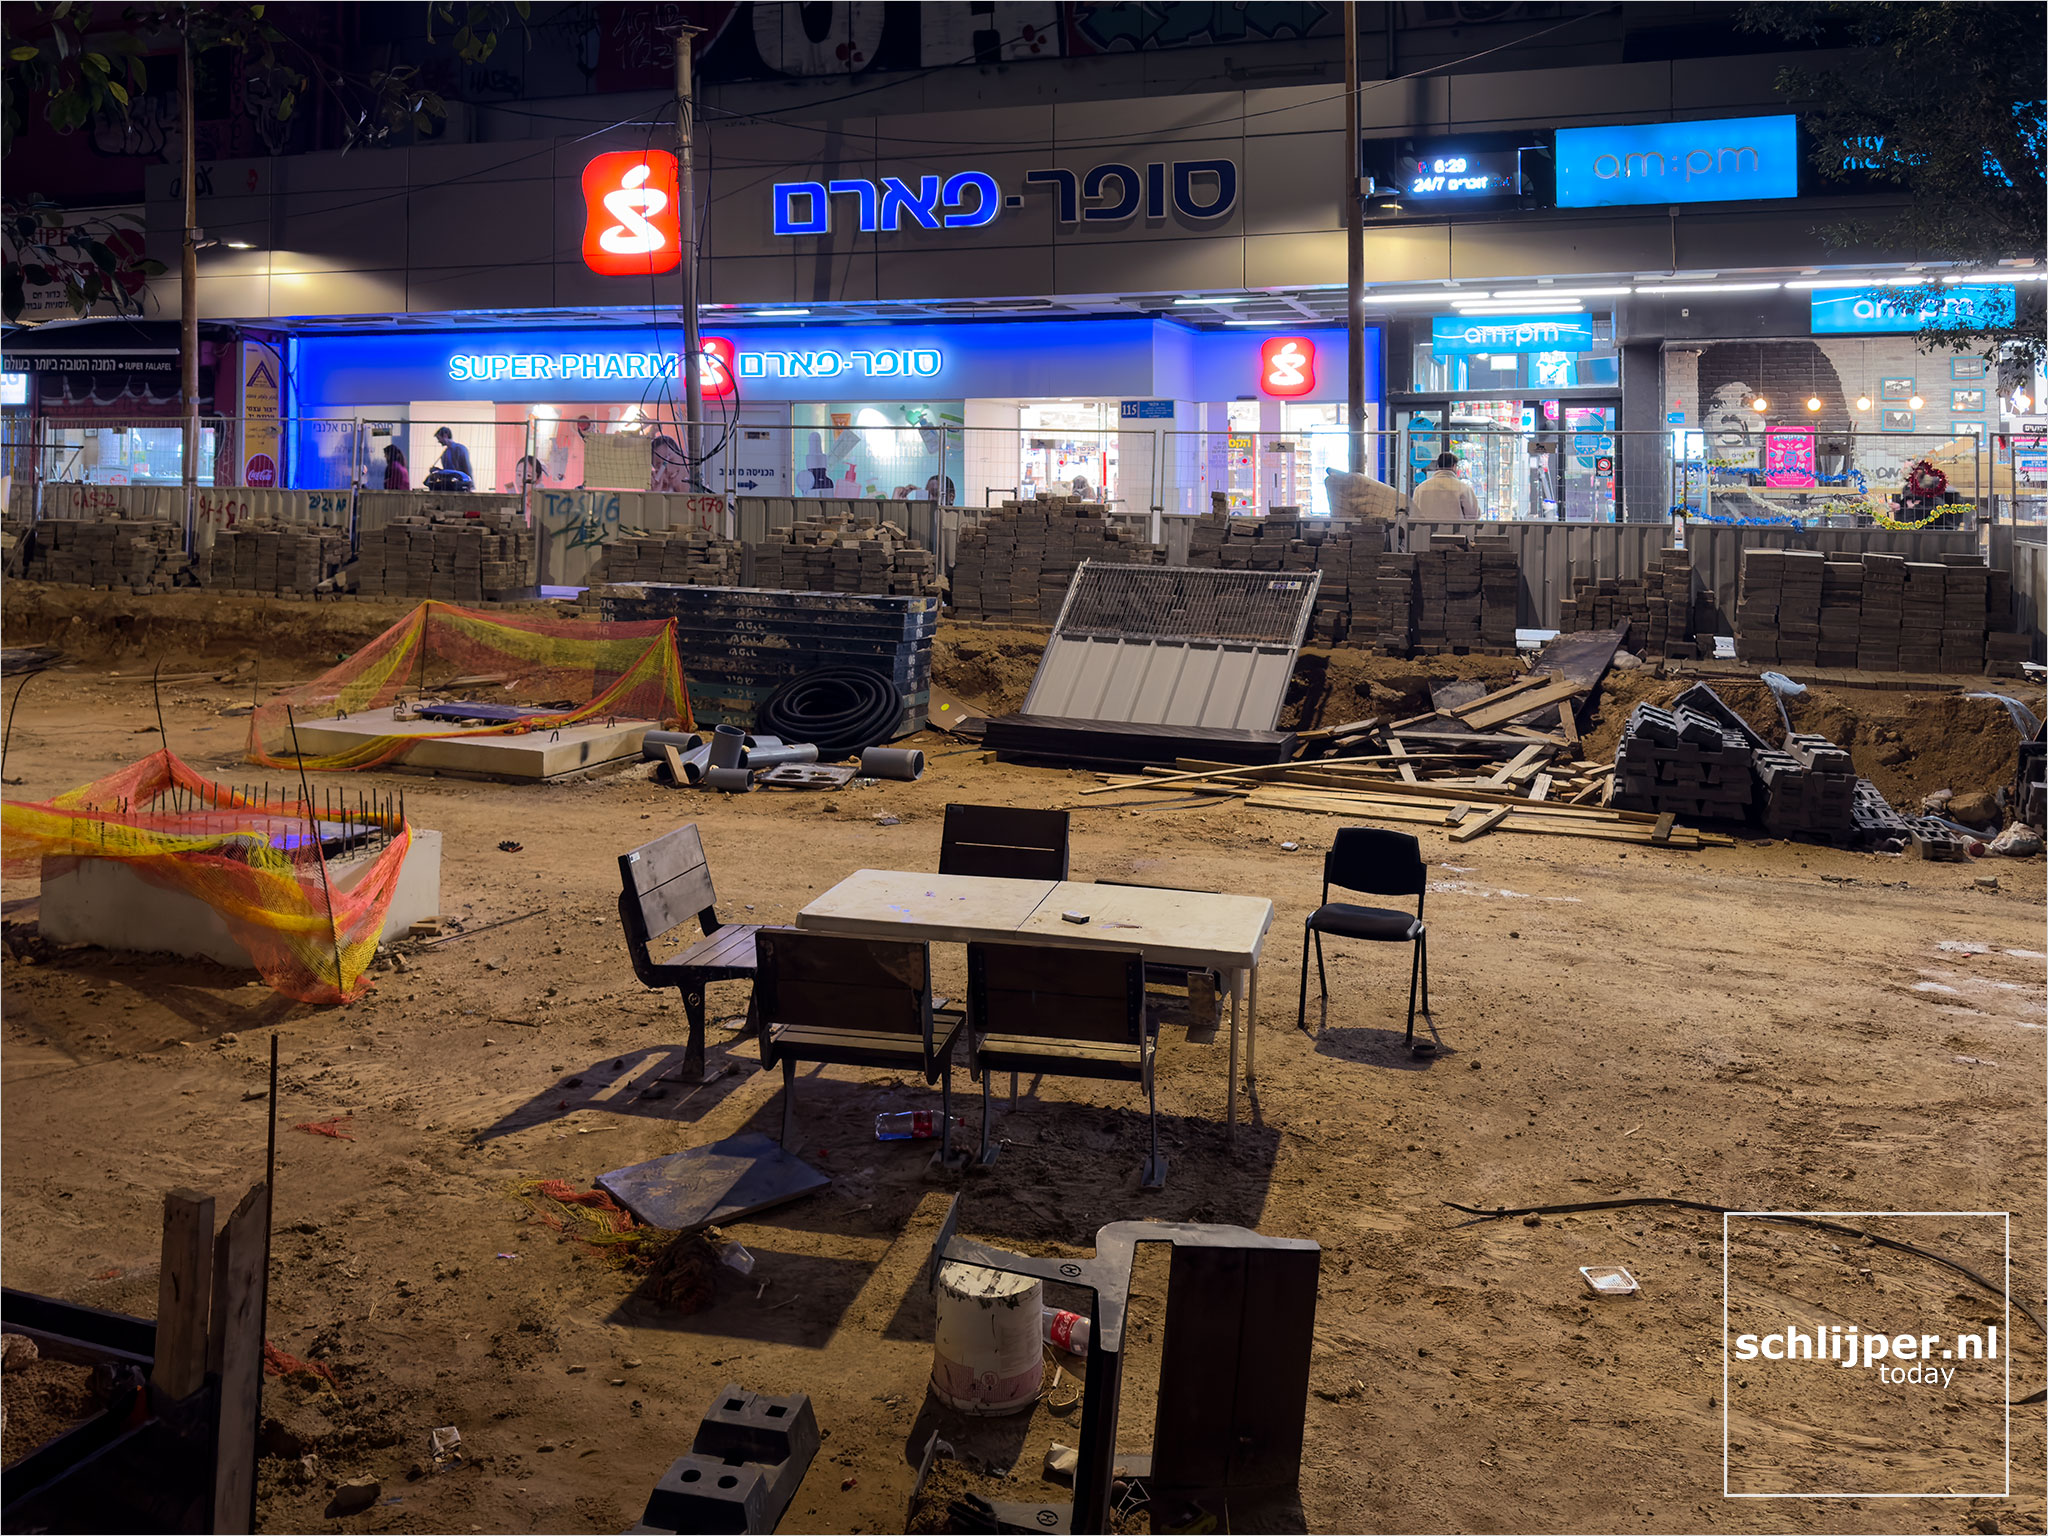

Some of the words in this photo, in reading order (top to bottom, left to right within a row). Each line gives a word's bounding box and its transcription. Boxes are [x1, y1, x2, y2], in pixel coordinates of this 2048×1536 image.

[1593, 146, 1759, 182] am:pm
[1413, 176, 1446, 192] 24/7
[773, 159, 1239, 236] סופר-פארם
[3, 354, 30, 371] בעולם
[34, 359, 58, 371] ביותר
[60, 359, 89, 371] הטובה
[91, 359, 116, 371] המנה
[124, 362, 144, 371] SUPER
[145, 362, 172, 371] FALAFEL
[448, 353, 680, 381] SUPER-PHARM
[738, 349, 943, 378] סופר-פארם
[1122, 404, 1137, 415] 115
[746, 468, 775, 476] הכניסה
